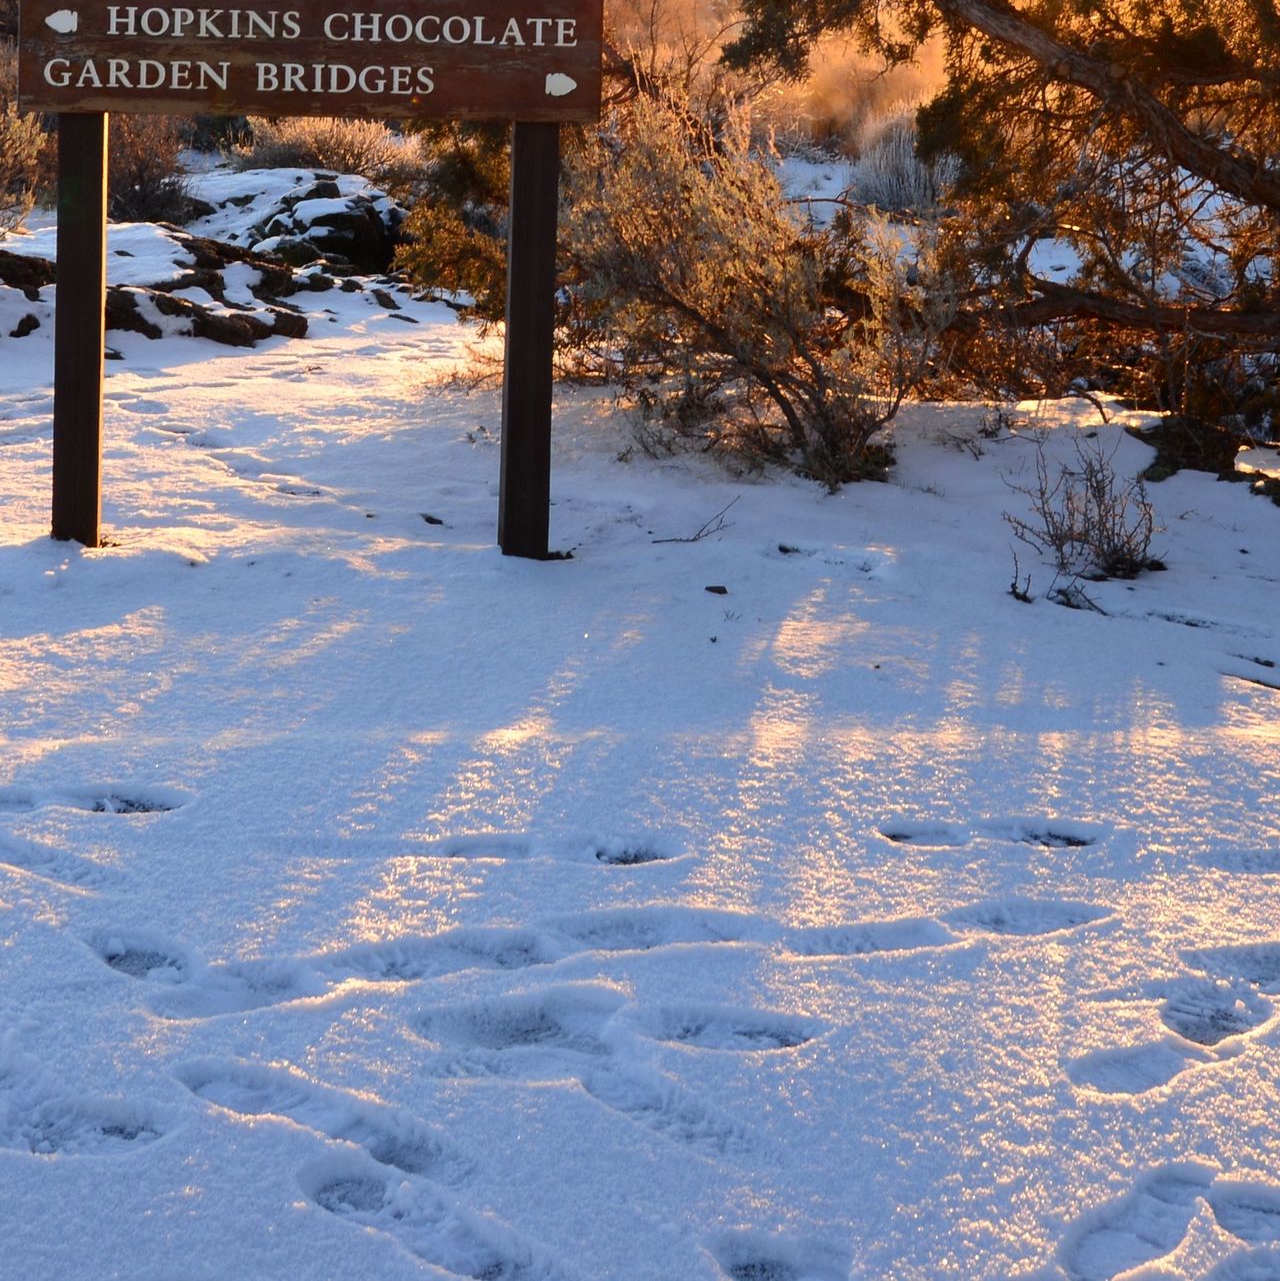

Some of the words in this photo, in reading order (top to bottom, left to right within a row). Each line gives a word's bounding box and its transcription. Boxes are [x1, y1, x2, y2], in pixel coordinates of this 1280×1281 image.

[106, 5, 302, 40] HOPKINS
[323, 12, 579, 48] CHOCOLATE
[43, 57, 231, 91] GARDEN
[255, 62, 436, 96] BRIDGES
